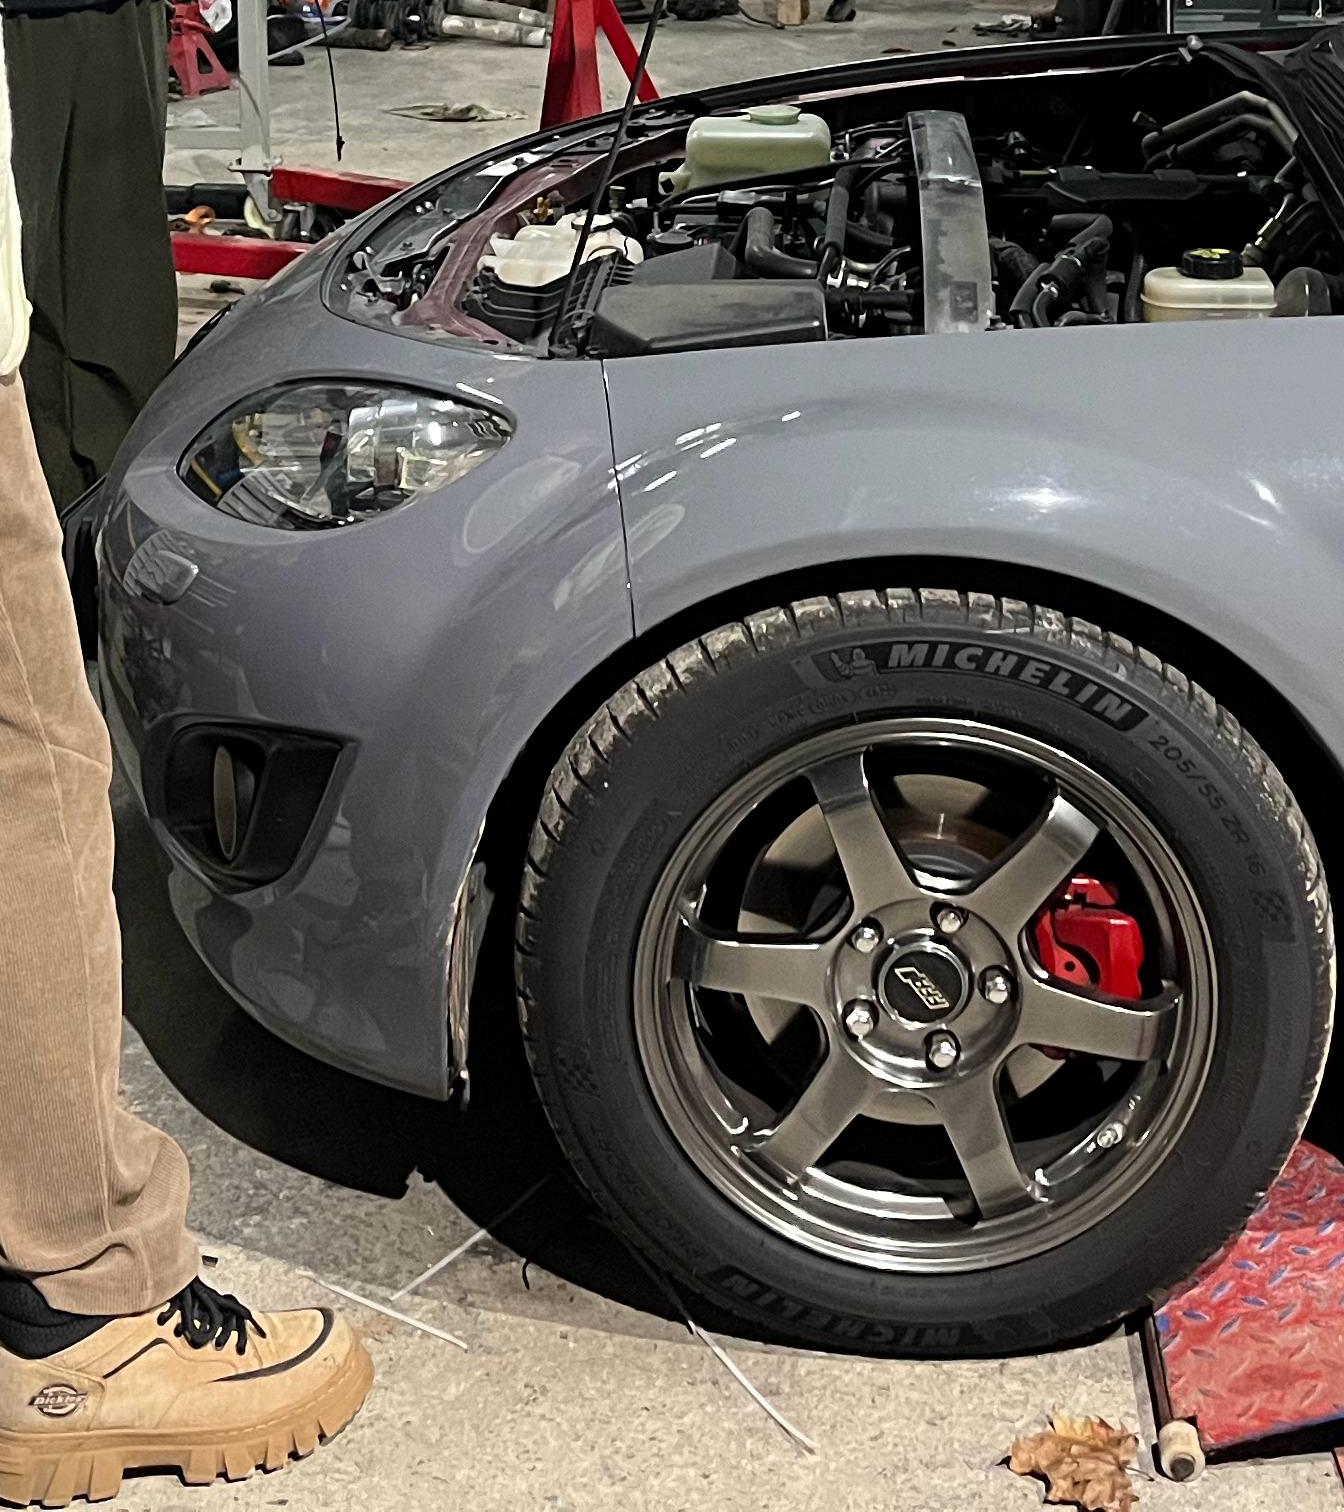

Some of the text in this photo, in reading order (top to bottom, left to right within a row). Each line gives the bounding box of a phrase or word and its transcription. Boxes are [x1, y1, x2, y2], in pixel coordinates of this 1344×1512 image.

[887, 643, 1134, 723] MICHELIN
[1148, 735, 1228, 810] 205/55
[717, 1273, 961, 1346] MICHELIN
